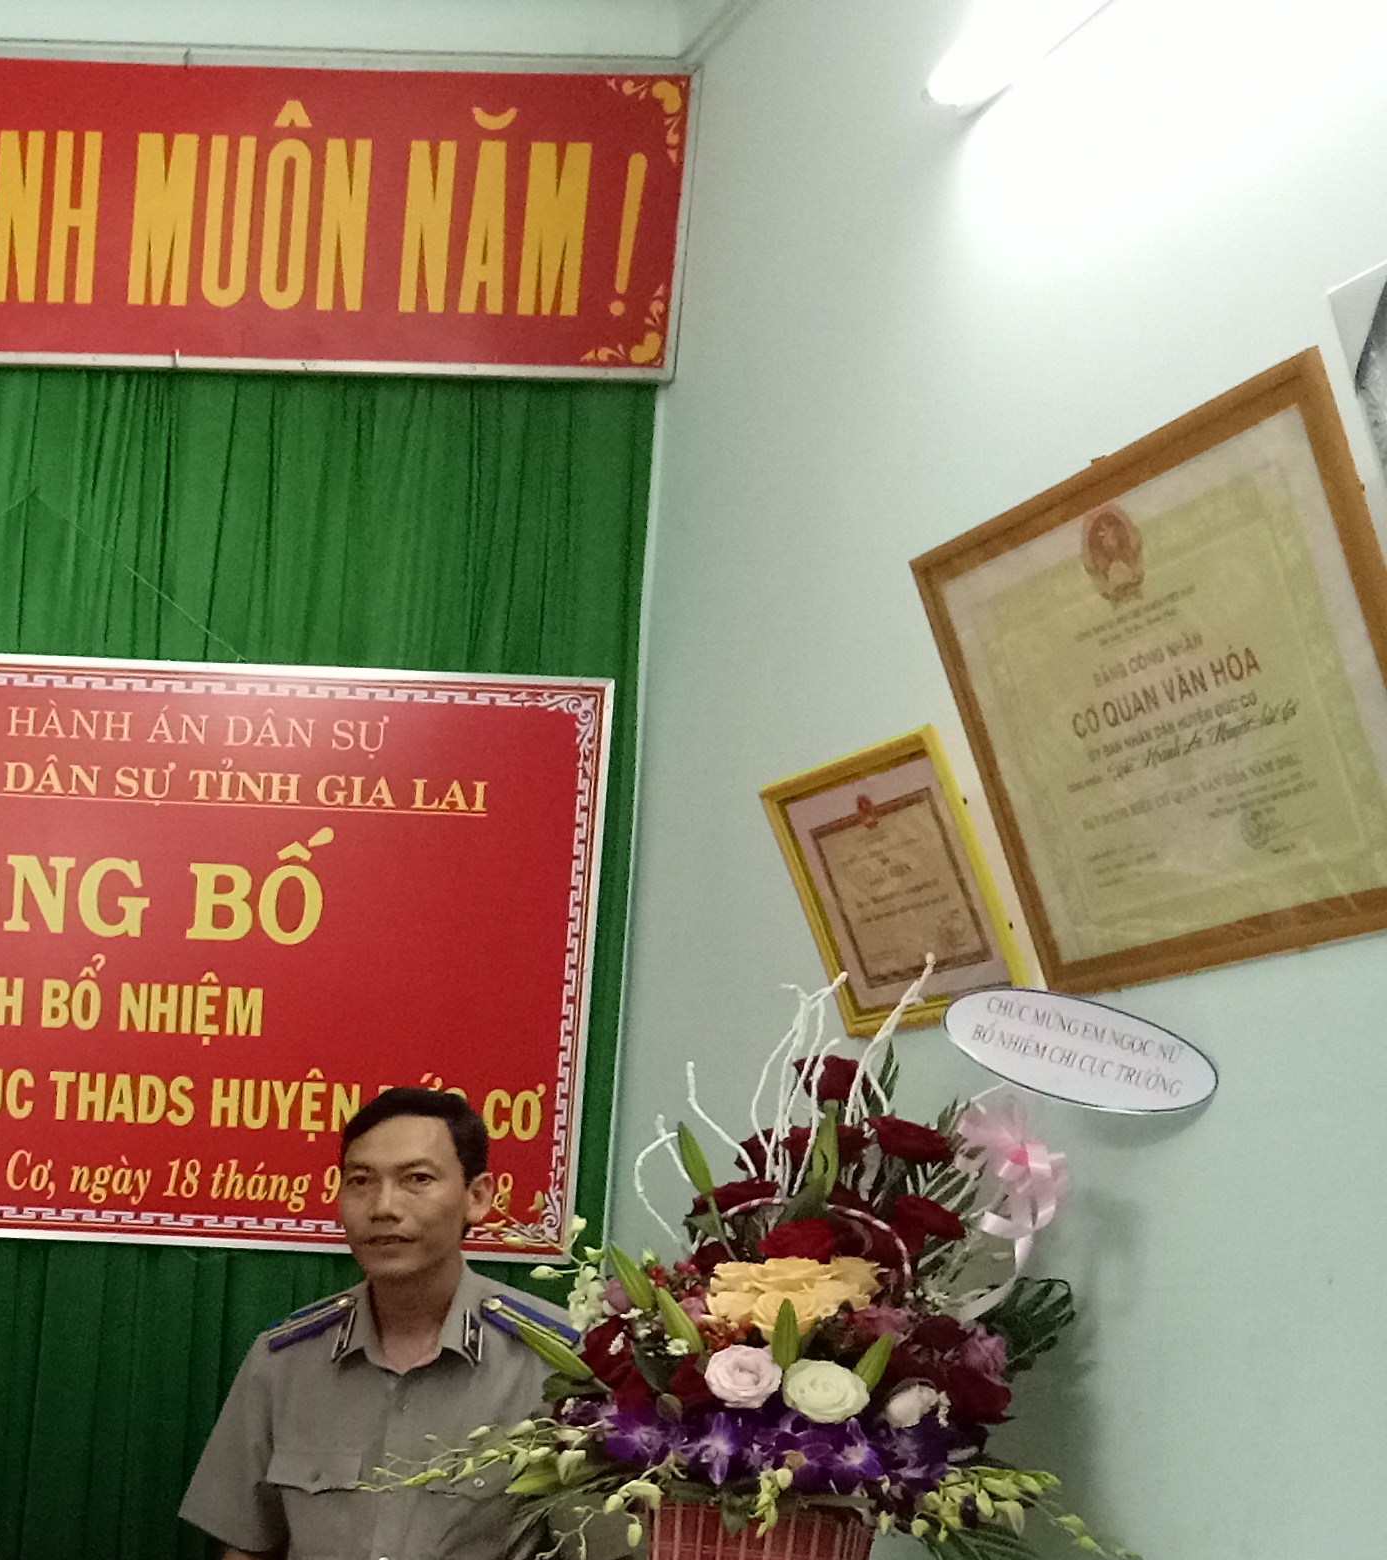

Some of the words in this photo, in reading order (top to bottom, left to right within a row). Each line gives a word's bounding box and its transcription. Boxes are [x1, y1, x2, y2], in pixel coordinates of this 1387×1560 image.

[128, 99, 372, 312] MUÔN
[398, 106, 593, 317] NĂM
[8, 698, 132, 743] HÀNH
[147, 705, 209, 746] ÁN
[226, 709, 315, 749] DÂN
[331, 714, 390, 759] SỰ
[1102, 684, 1162, 728] QUAN
[1162, 666, 1209, 704] VĂN
[3, 753, 101, 798] DÂN
[114, 761, 176, 806] SỰ
[188, 757, 301, 805] TỈNH
[316, 774, 396, 809] GIA
[411, 778, 489, 813] LAI
[185, 826, 335, 945] BỐ
[40, 953, 106, 1031] BỔ
[119, 971, 264, 1046] NHIỆM
[986, 995, 1030, 1023] CHÚC
[1081, 1022, 1107, 1044] EM
[1048, 1046, 1078, 1069] CHI
[49, 1069, 195, 1128] THADS
[210, 1068, 362, 1142] HUYỆN
[482, 1082, 547, 1142] CƠ
[6, 1149, 56, 1200] Cơ,
[69, 1155, 153, 1204] ngày
[163, 1157, 202, 1200] 18
[211, 1159, 312, 1213] tháng
[320, 1165, 342, 1204] 9
